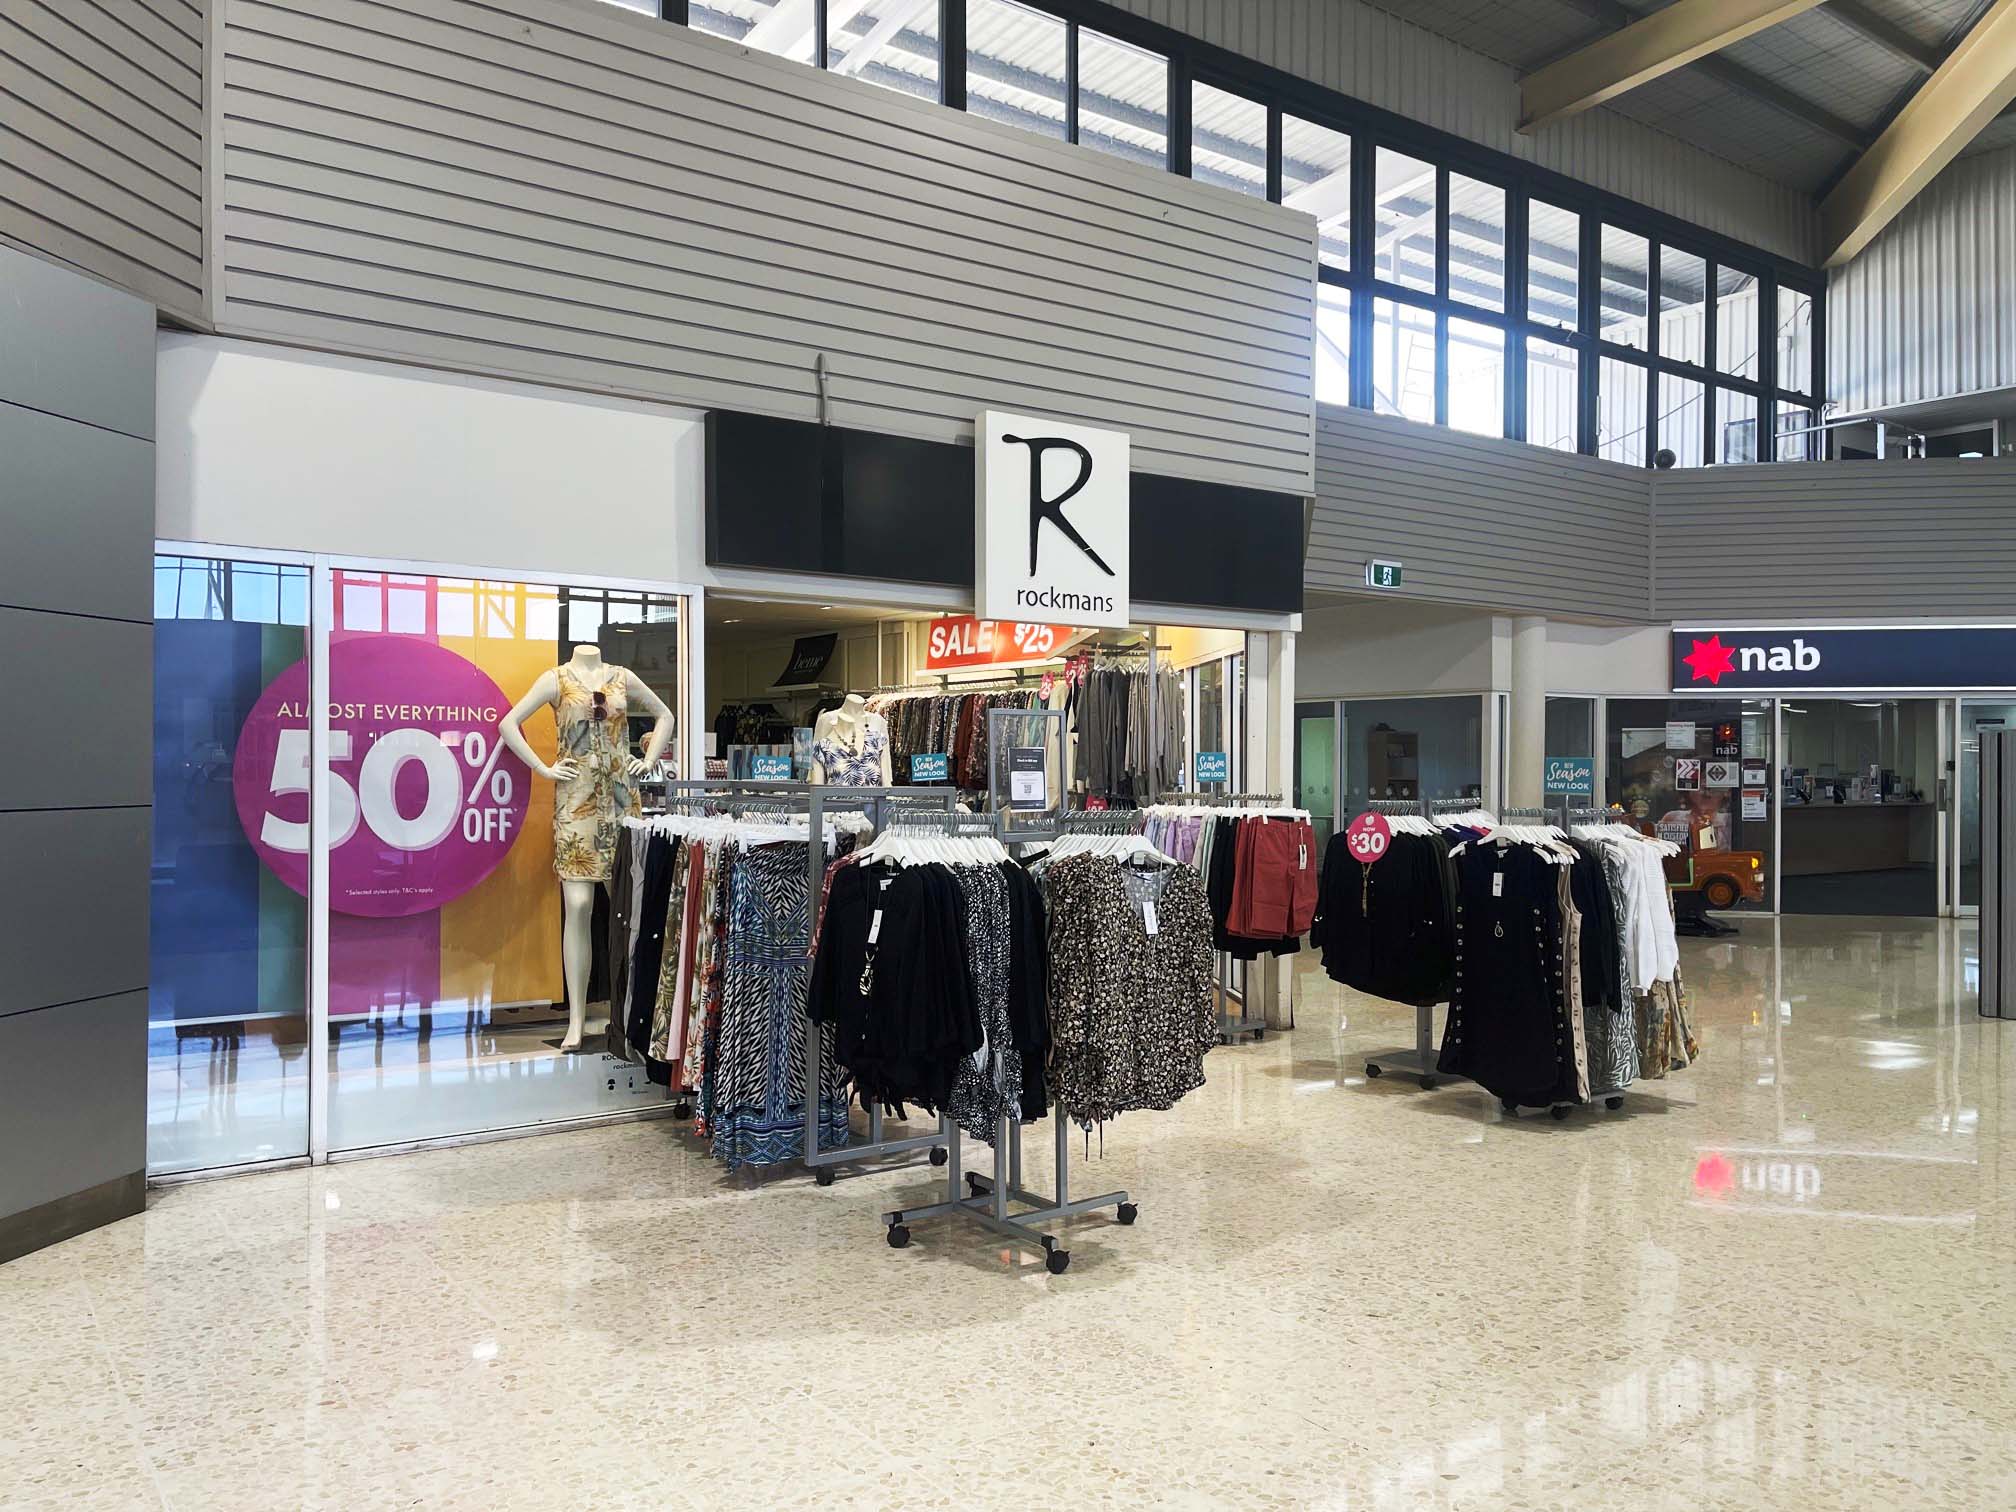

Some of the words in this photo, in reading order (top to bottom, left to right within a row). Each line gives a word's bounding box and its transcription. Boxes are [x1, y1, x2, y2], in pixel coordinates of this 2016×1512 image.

[1001, 433, 1115, 577] R
[1017, 586, 1113, 612] rockmans
[930, 621, 993, 659] SALE
[1014, 623, 1053, 653] $25
[1739, 638, 1821, 672] nab
[277, 702, 366, 719] ALOST
[374, 704, 498, 722] EVERYTHING
[1716, 746, 1738, 755] nab
[754, 759, 789, 774] Season
[914, 758, 945, 771] Season
[1198, 756, 1225, 771] Season
[1547, 762, 1590, 781] Season
[1548, 782, 1566, 790] NEW
[1567, 782, 1589, 790] LOOK
[1351, 832, 1385, 853] $30
